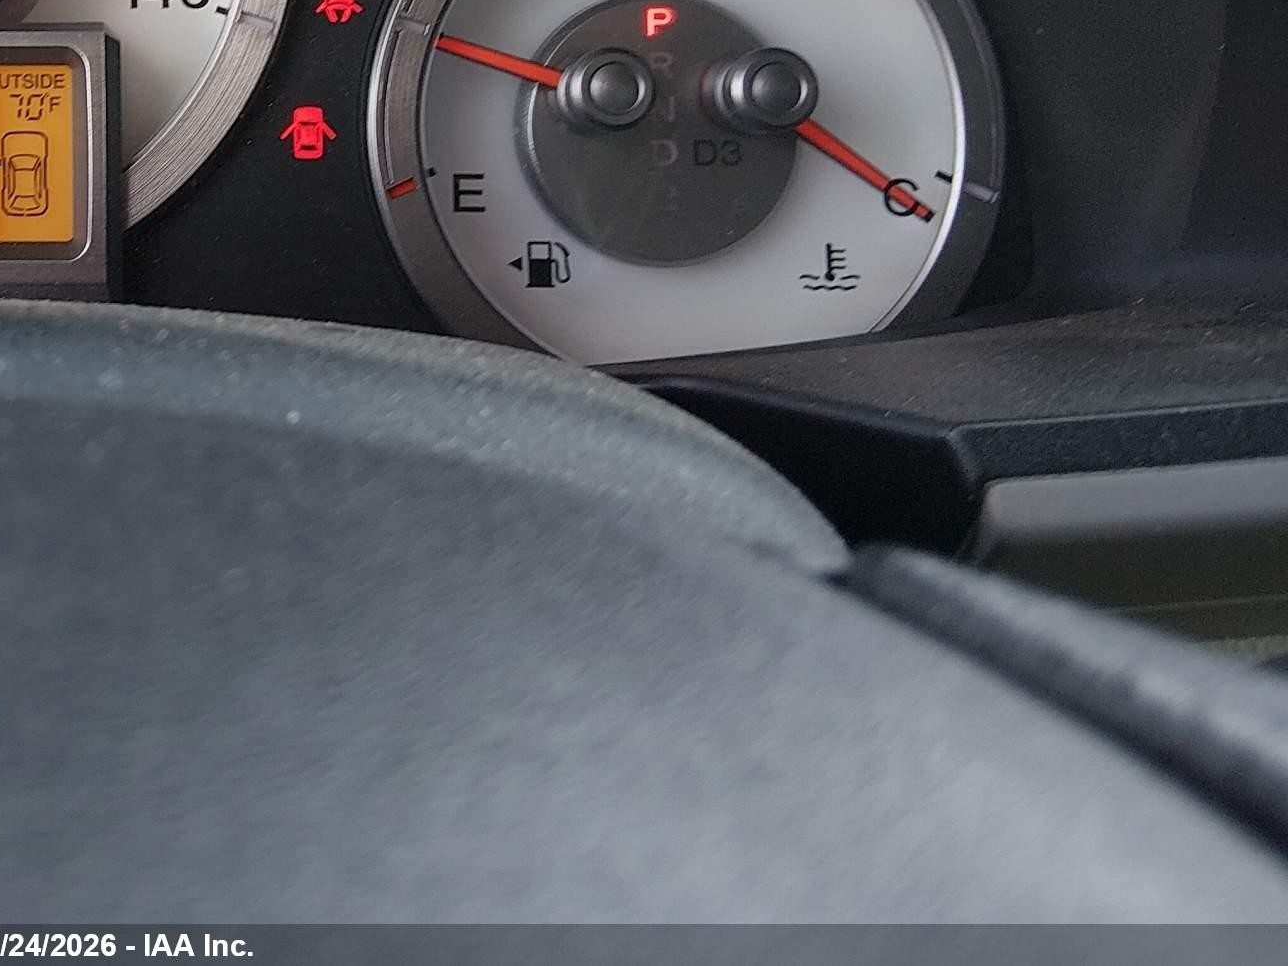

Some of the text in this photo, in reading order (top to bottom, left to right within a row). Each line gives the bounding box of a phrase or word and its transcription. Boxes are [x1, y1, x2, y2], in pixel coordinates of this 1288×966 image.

[645, 8, 674, 36] P
[649, 52, 673, 77] R
[693, 139, 743, 166] D3
[454, 173, 485, 212] E
[883, 178, 919, 216] C
